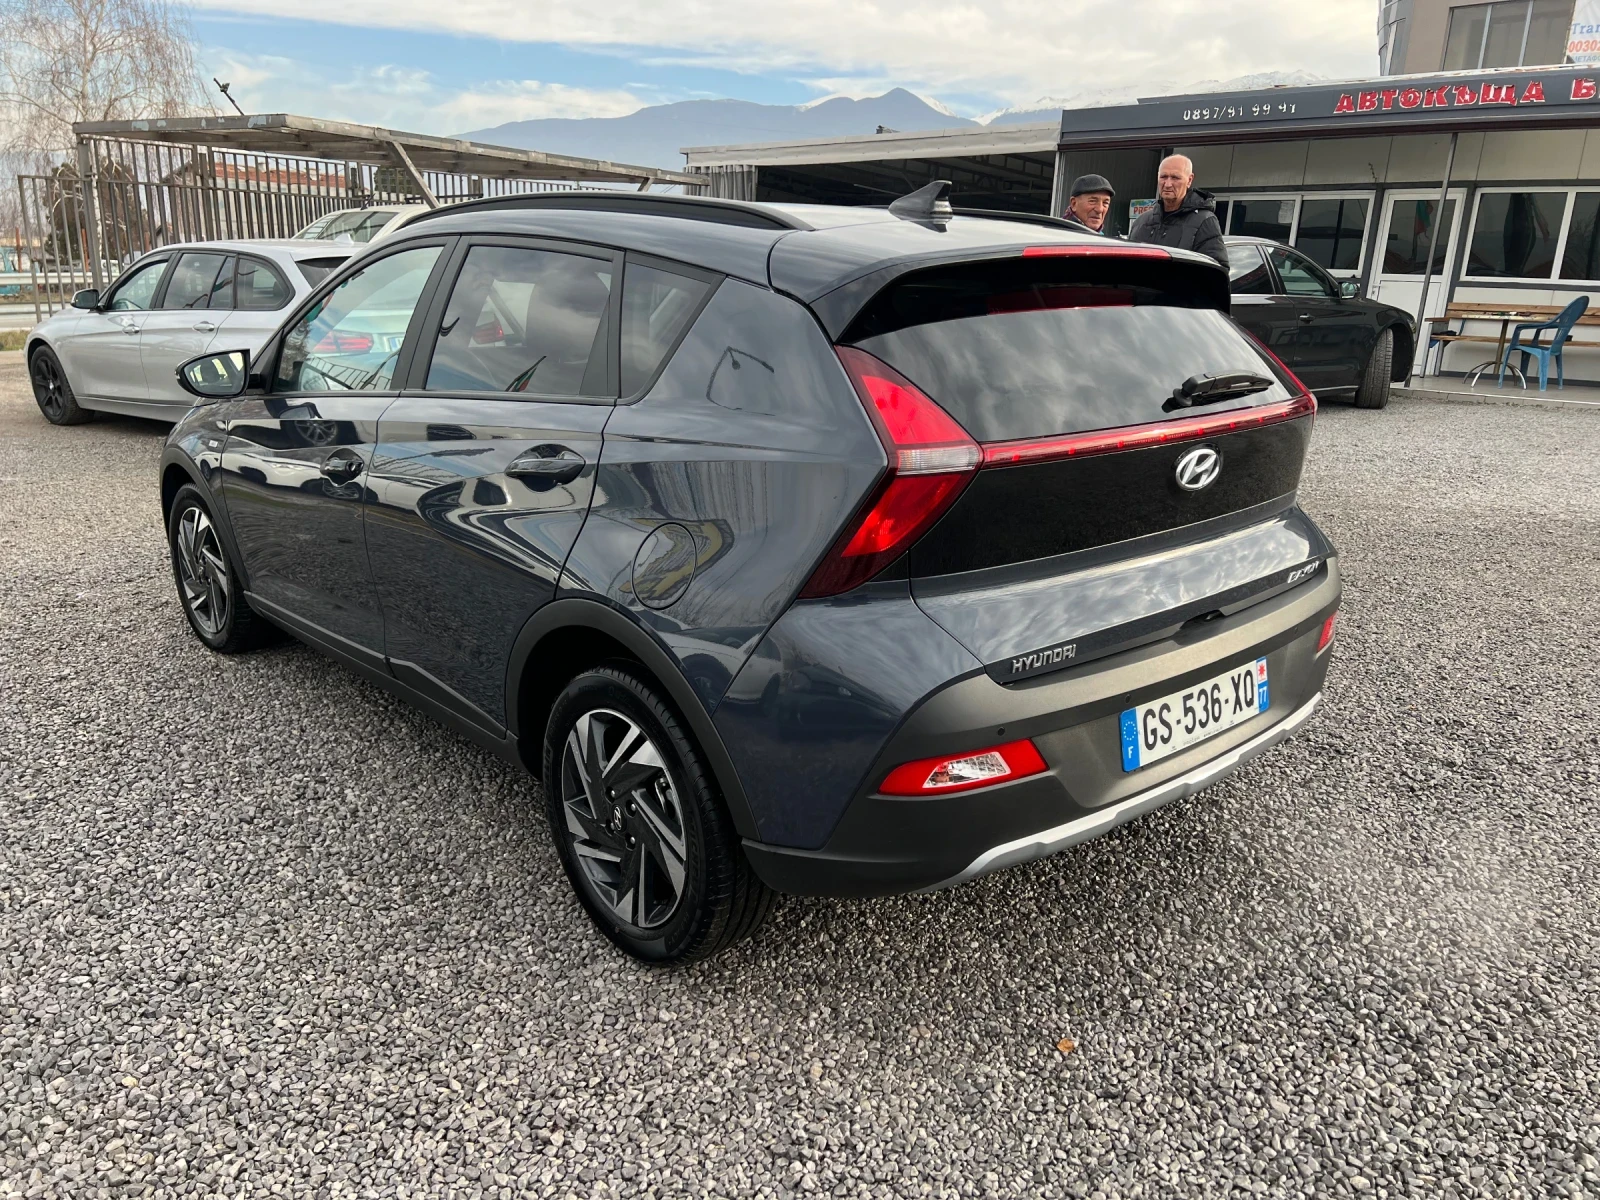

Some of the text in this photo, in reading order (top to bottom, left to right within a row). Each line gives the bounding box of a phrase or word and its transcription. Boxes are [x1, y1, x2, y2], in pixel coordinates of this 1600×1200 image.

[1252, 103, 1271, 116] 99
[1333, 80, 1546, 114] АВТОКЪЩА
[1569, 77, 1600, 101] Б
[1012, 644, 1077, 674] HYUNDAI
[1258, 686, 1268, 705] 77
[1127, 745, 1135, 759] F
